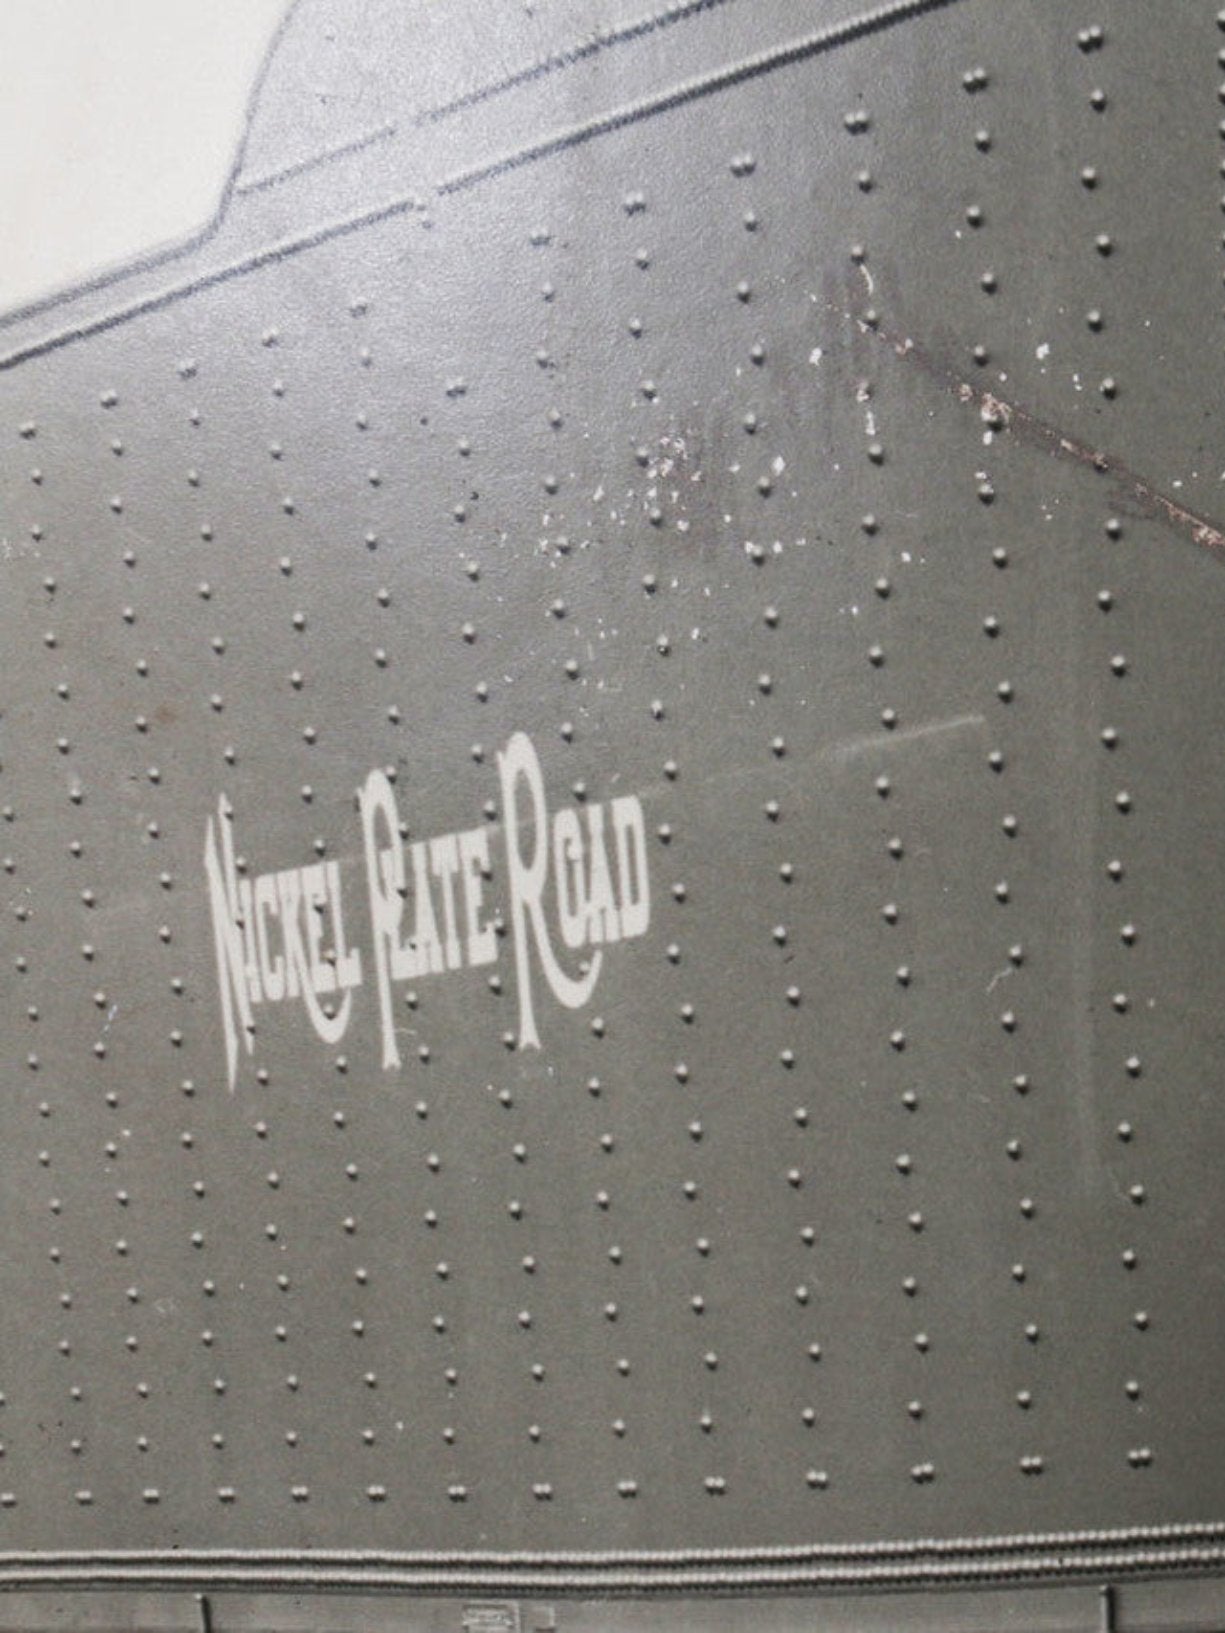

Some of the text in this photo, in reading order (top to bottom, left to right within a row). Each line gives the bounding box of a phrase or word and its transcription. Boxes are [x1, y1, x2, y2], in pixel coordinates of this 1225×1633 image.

[205, 731, 650, 1094] NICKEL PLATE ROAD
